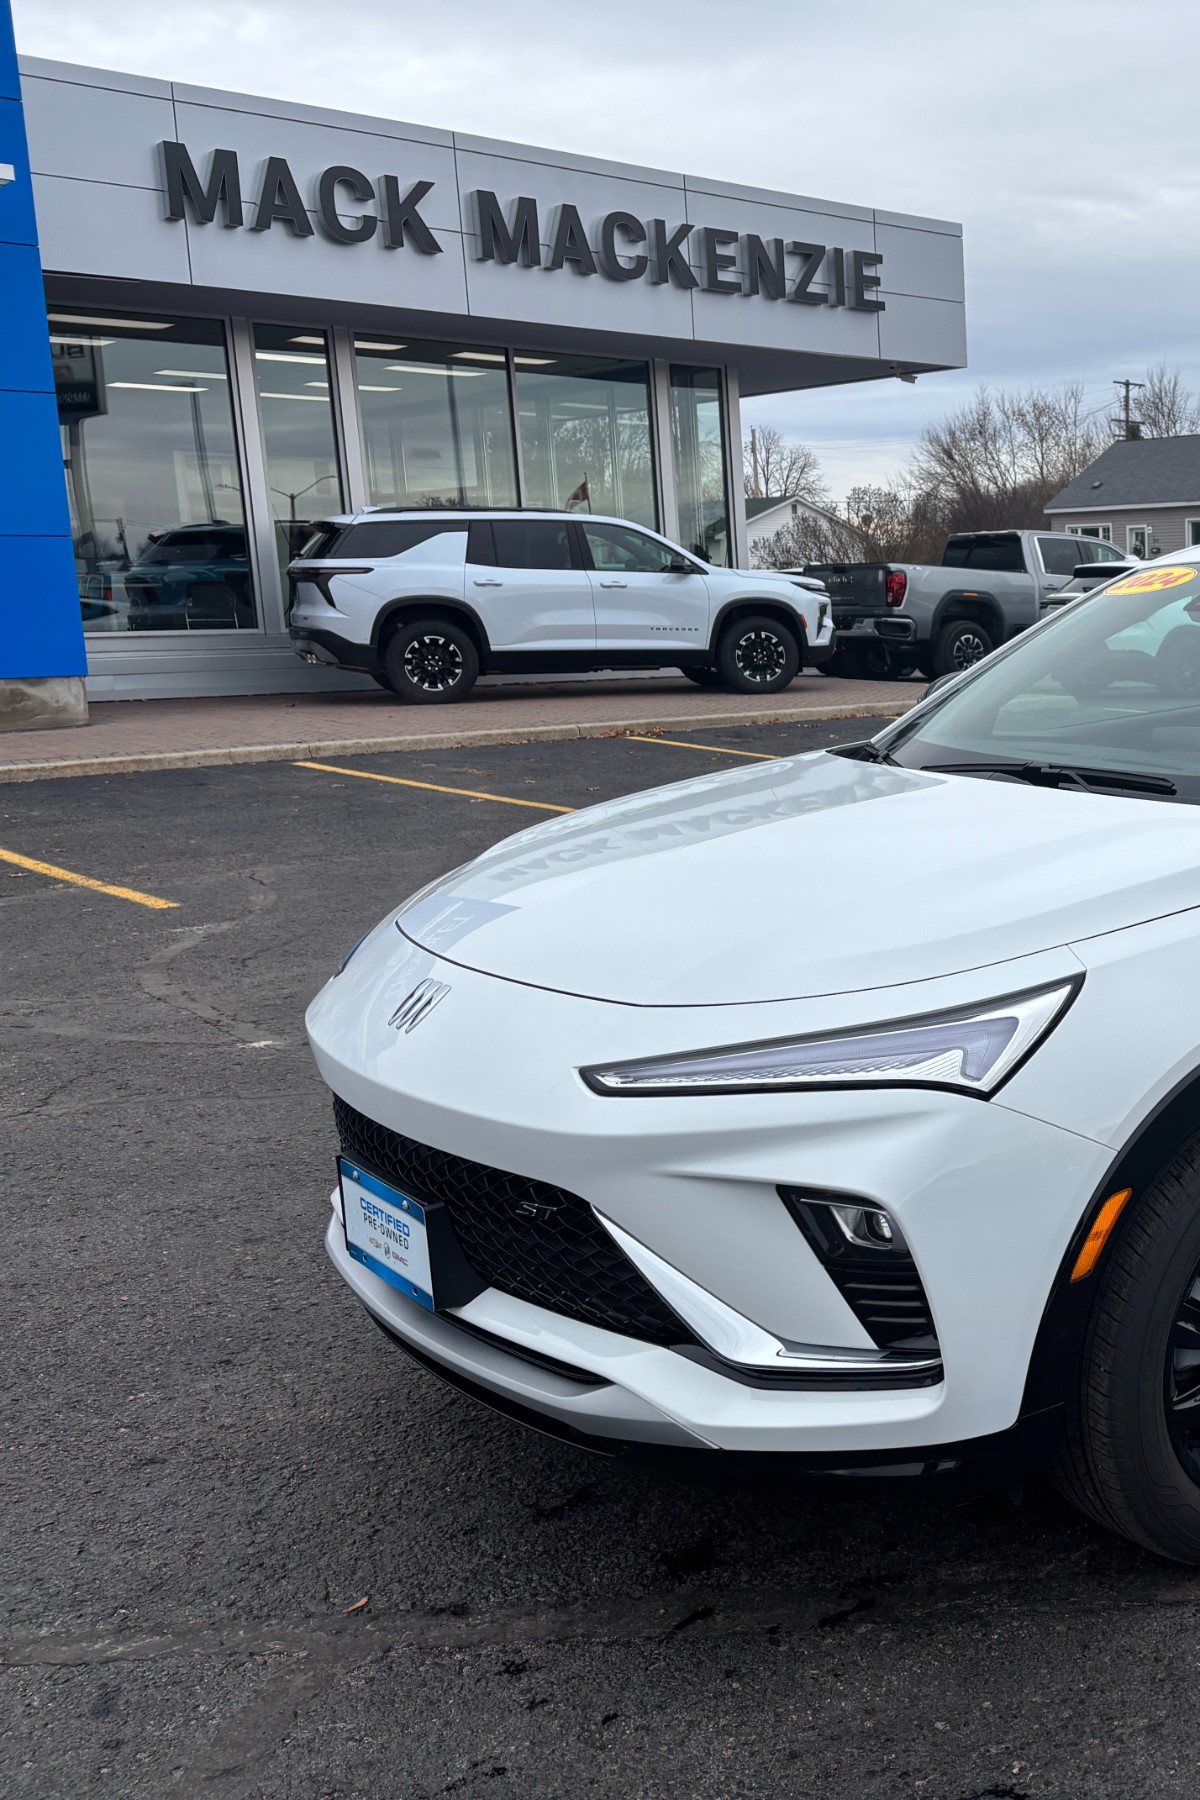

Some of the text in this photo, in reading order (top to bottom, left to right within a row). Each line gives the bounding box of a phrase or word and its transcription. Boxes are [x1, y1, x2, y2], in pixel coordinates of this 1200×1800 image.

[157, 140, 886, 312] MACK MACKENZIE
[1110, 572, 1194, 591] 2024
[360, 1197, 410, 1238] CERTIFIED
[515, 1201, 558, 1220] ST
[364, 1213, 410, 1250] PRE-OWNED
[392, 1252, 409, 1267] GMC
